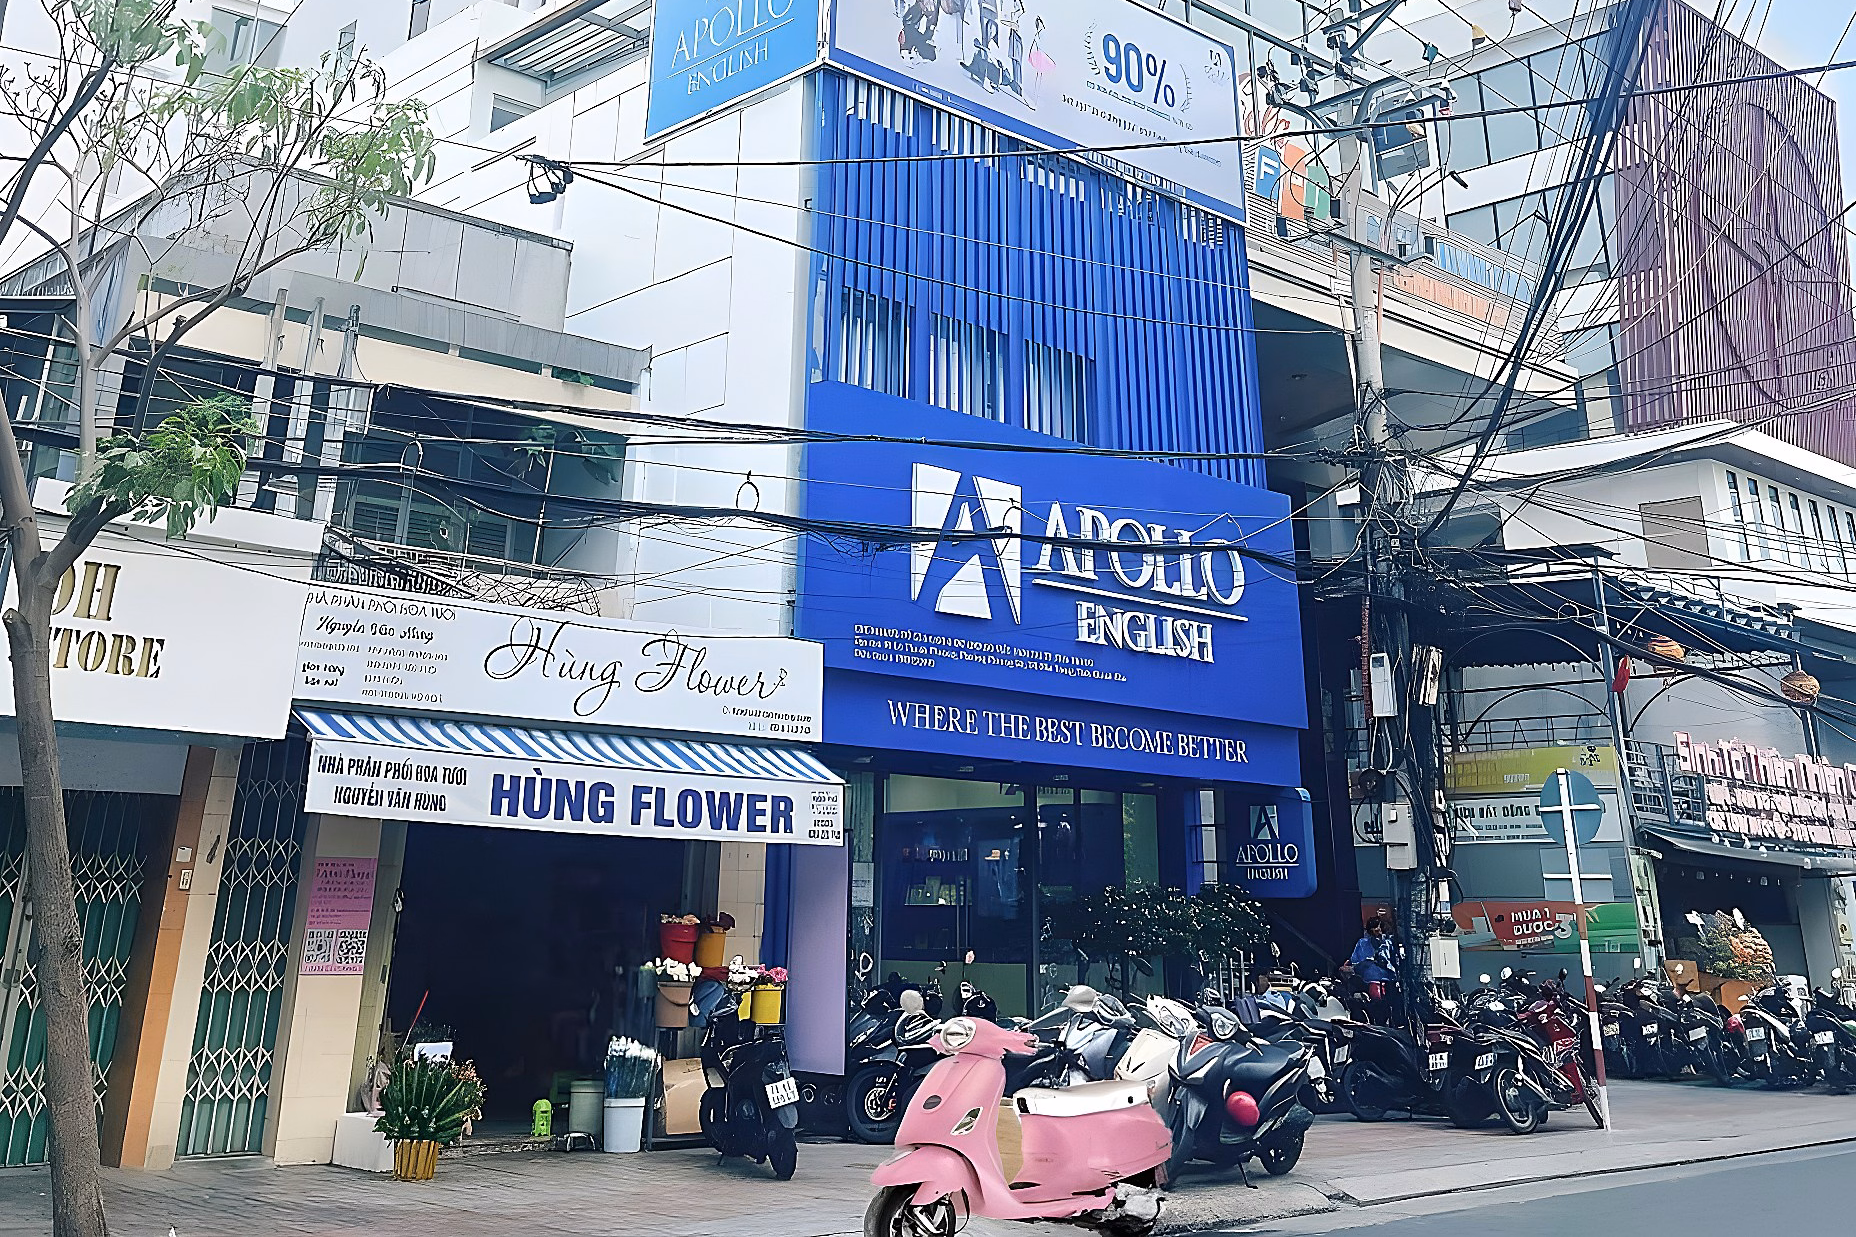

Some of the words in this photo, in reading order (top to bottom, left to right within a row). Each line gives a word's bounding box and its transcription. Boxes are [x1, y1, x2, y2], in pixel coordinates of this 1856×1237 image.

[1103, 34, 1176, 108] 90%
[1035, 501, 1247, 606] APOLLO
[49, 627, 165, 679] TORE
[1076, 601, 1215, 664] ENGLISH
[484, 616, 622, 717] Hùng
[635, 629, 782, 699] Flower
[888, 699, 978, 736] WHERE
[983, 711, 1031, 741] THE
[1035, 718, 1085, 747] BEST
[1091, 723, 1174, 756] BECOME
[1178, 734, 1249, 764] BETTER
[317, 753, 344, 775] NHÀ
[490, 768, 615, 824] HÙNG
[631, 784, 795, 835] FLOWER
[1236, 843, 1299, 863] APOLLO
[1511, 909, 1541, 923] MUA
